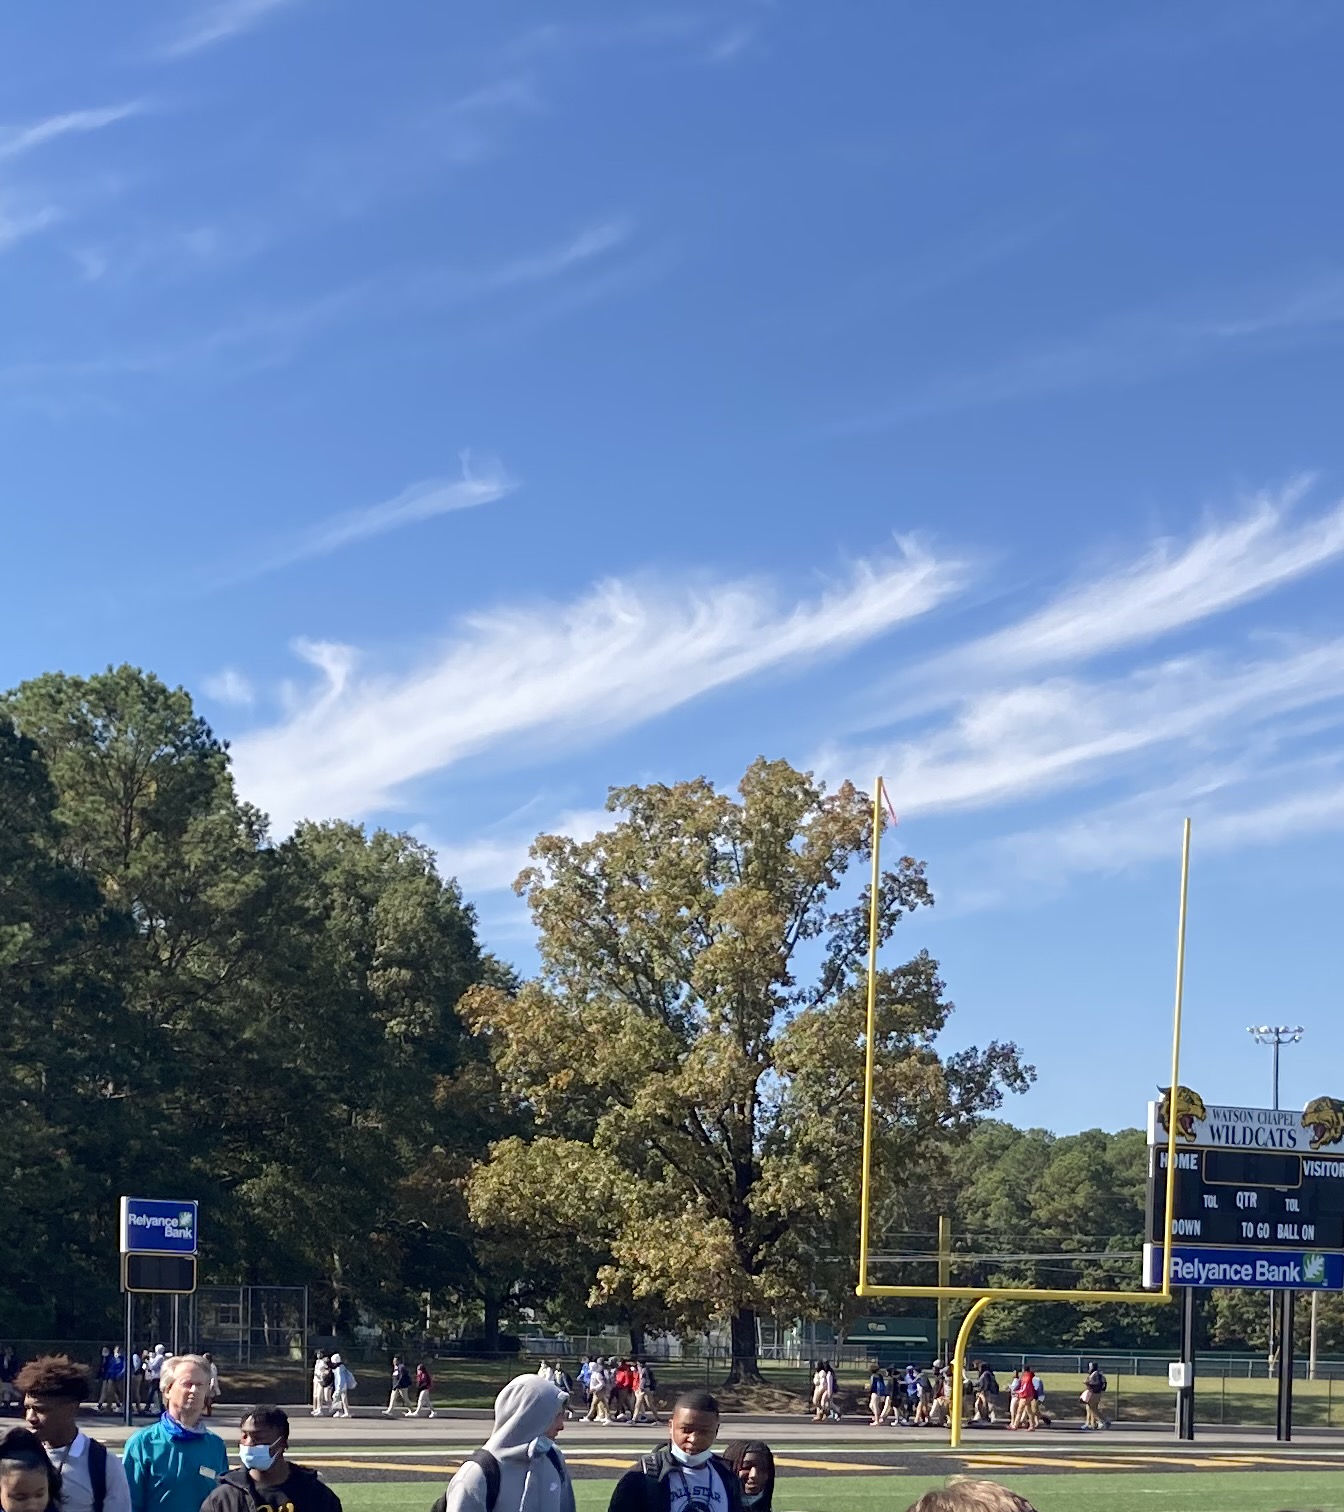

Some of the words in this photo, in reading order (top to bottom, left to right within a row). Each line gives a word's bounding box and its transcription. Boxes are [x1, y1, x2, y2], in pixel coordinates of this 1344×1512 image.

[1212, 1108, 1253, 1124] WATSON
[1257, 1110, 1296, 1127] CHAPEL
[1209, 1124, 1297, 1149] WILDCATS
[1203, 1194, 1218, 1209] TOL
[1236, 1191, 1258, 1209] QTR
[1285, 1198, 1300, 1213] TOL
[128, 1213, 179, 1229] Relyance
[1171, 1219, 1201, 1237] DOWN
[164, 1226, 193, 1239] Bank
[1241, 1222, 1254, 1238] TO
[1257, 1222, 1270, 1239] GO
[1277, 1223, 1299, 1240] BALL
[1301, 1224, 1315, 1241] ON
[1169, 1257, 1253, 1285] Relyance
[1256, 1260, 1301, 1283] Bank
